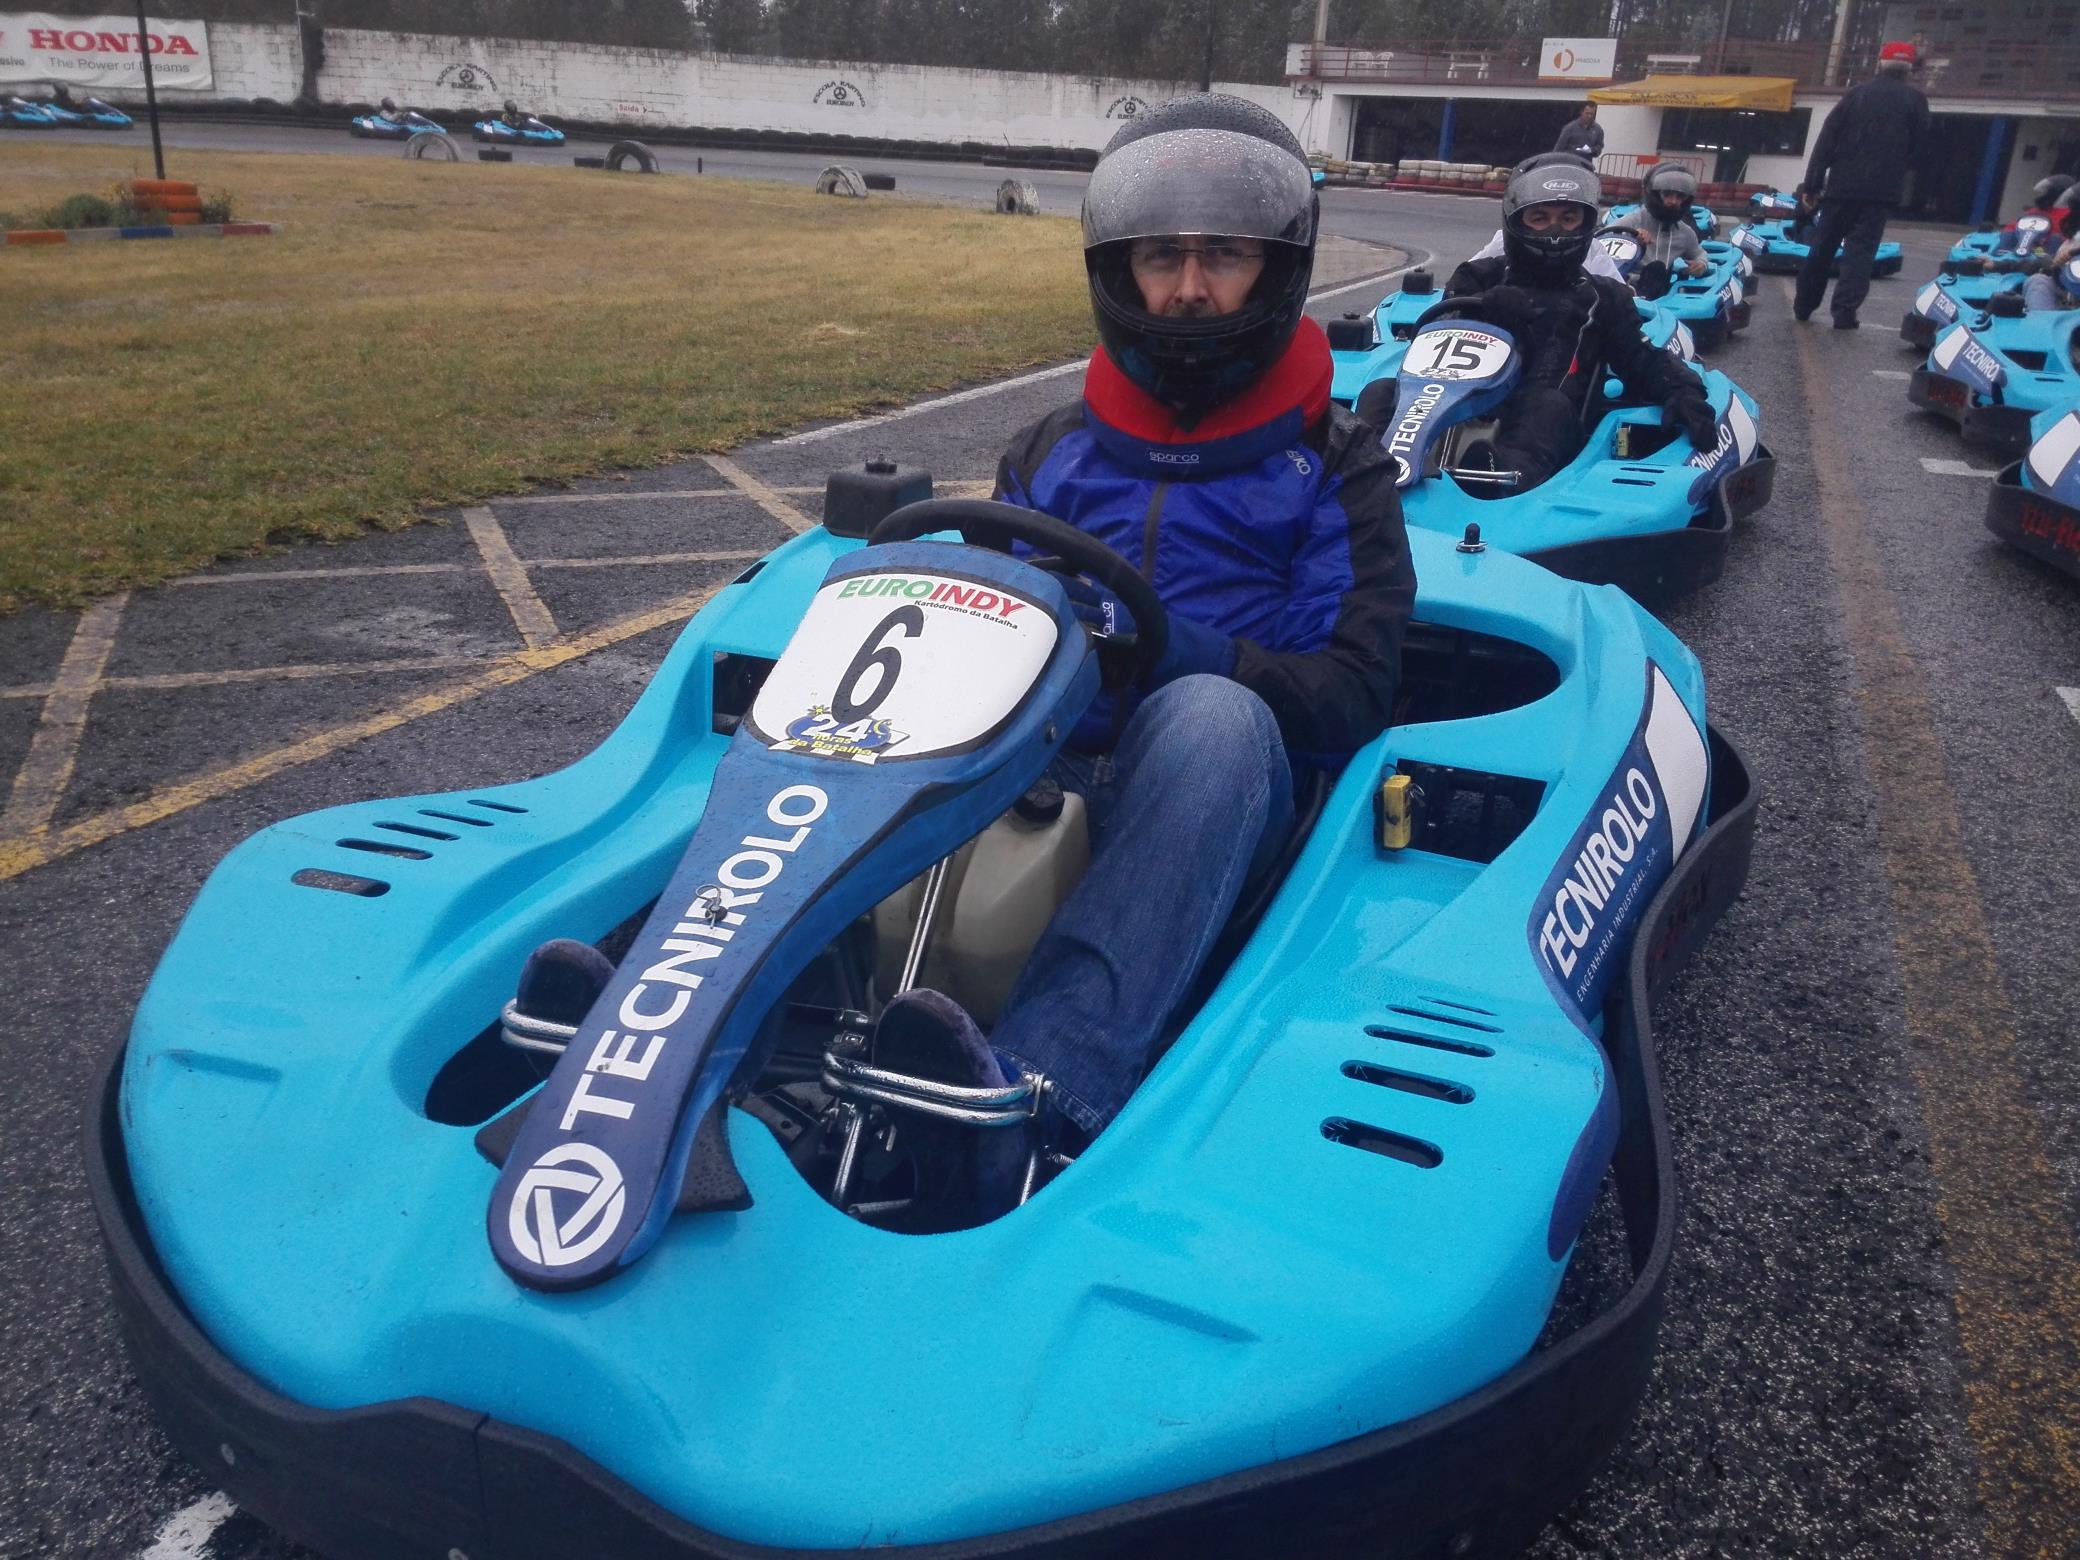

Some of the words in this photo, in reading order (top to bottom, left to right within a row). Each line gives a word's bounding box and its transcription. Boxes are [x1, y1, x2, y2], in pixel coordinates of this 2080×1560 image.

[28, 28, 199, 56] HONDA
[50, 57, 74, 69] The
[78, 58, 119, 71] Power
[123, 59, 136, 72] of
[140, 61, 190, 74] Dreams
[1605, 240, 1624, 256] 17
[1425, 331, 1498, 344] EUROINDY
[1432, 336, 1488, 370] 15
[1388, 383, 1445, 455] TECNIROLO
[838, 577, 1027, 618] EUROINDY
[914, 600, 968, 614] Kartódromo
[983, 613, 1019, 630] Batalha
[831, 604, 925, 725] 6
[801, 713, 874, 743] 24
[812, 732, 854, 744] horas
[811, 740, 874, 757] Batalha
[1539, 767, 1656, 980] TECNIROLO
[559, 784, 829, 1132] TECNIROLO
[1576, 929, 1615, 1003] ENGENHARIA
